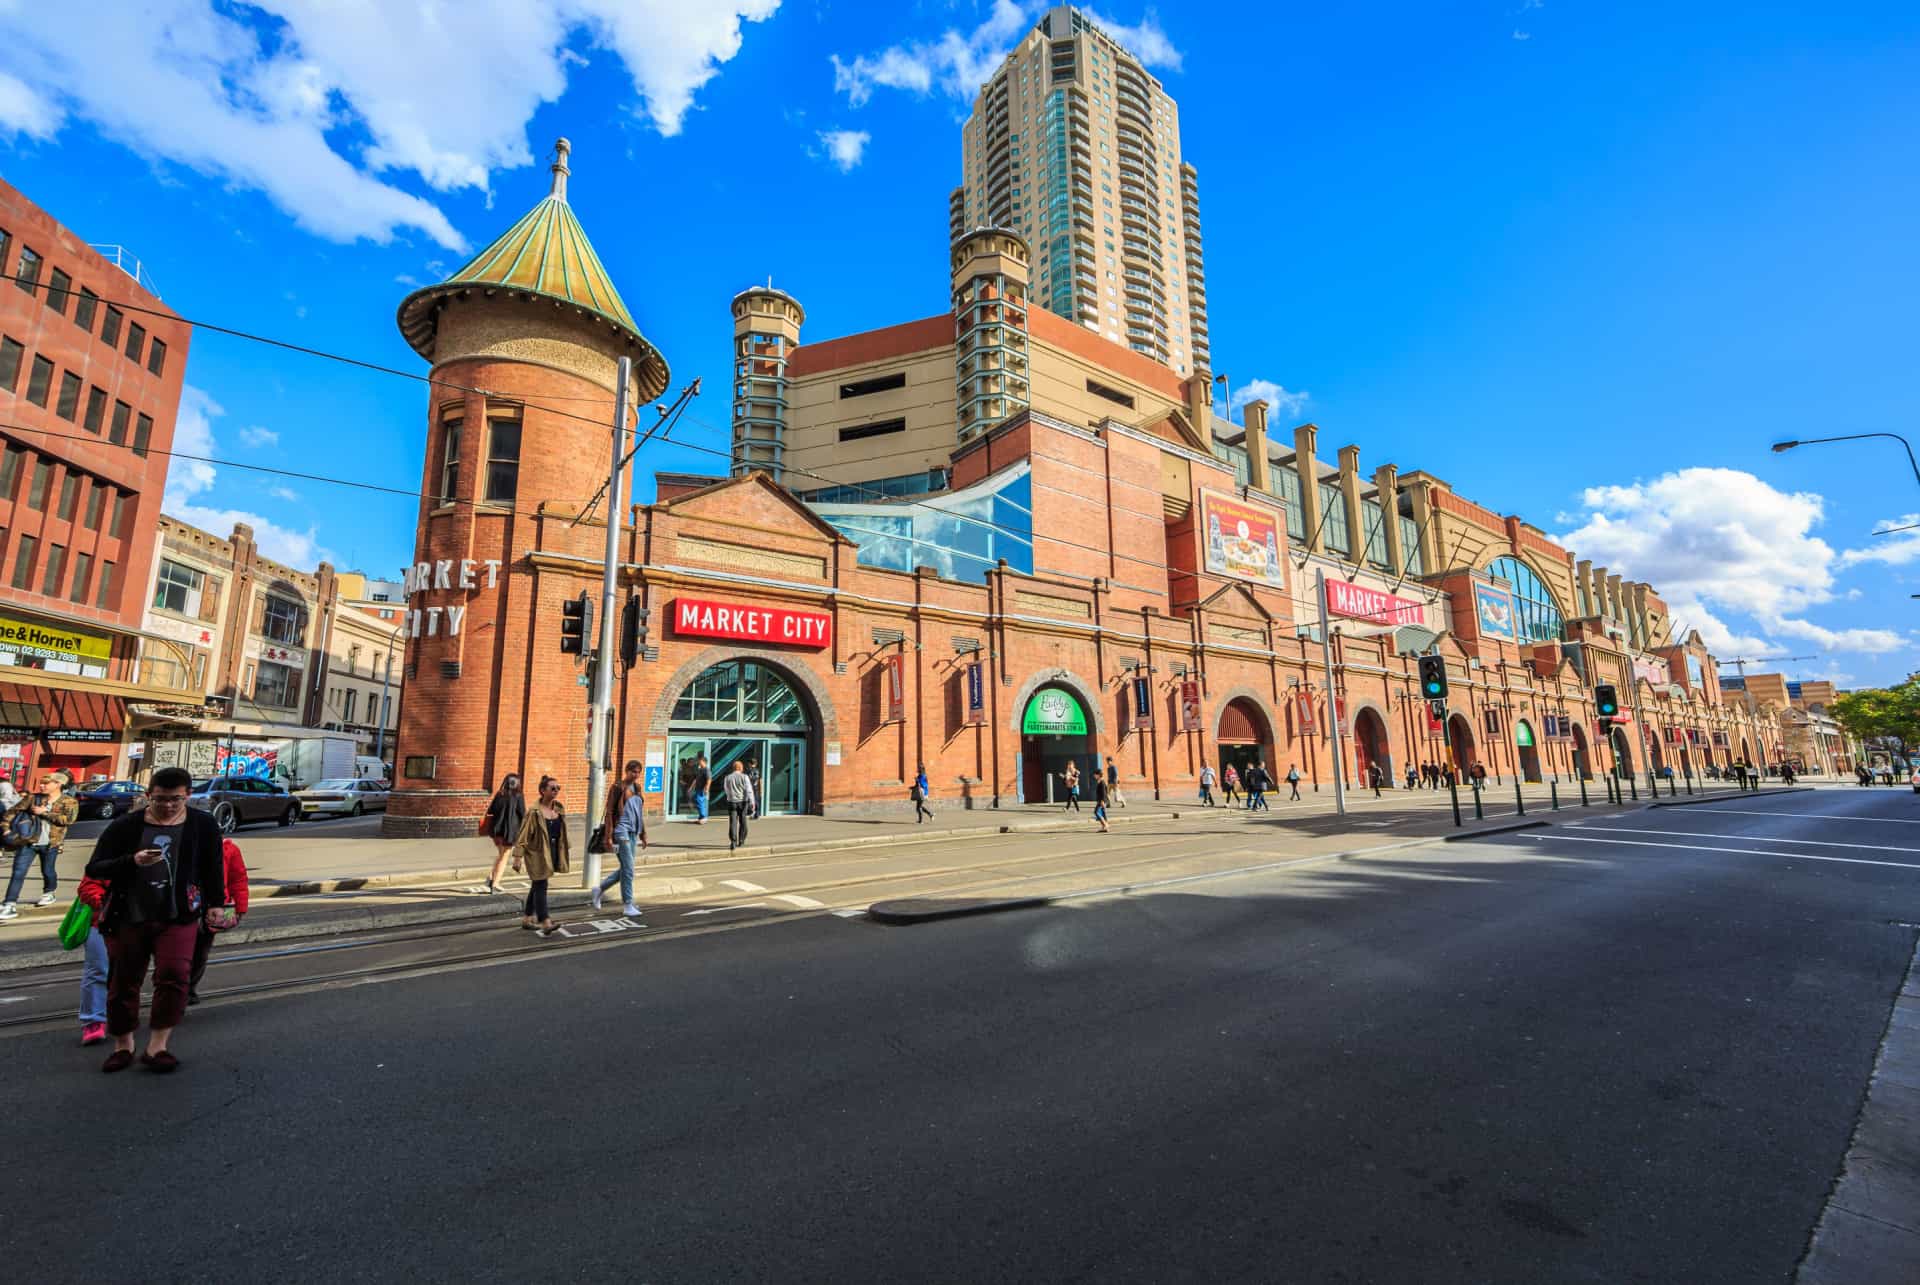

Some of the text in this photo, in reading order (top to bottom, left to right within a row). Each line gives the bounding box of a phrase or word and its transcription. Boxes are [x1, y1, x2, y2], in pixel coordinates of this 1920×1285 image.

[402, 559, 502, 598] ARKET
[682, 603, 826, 640] MARKET CITY
[1336, 584, 1419, 623] MARKET CITY
[16, 627, 28, 641] &
[29, 629, 73, 649] Horne
[22, 646, 33, 656] 02
